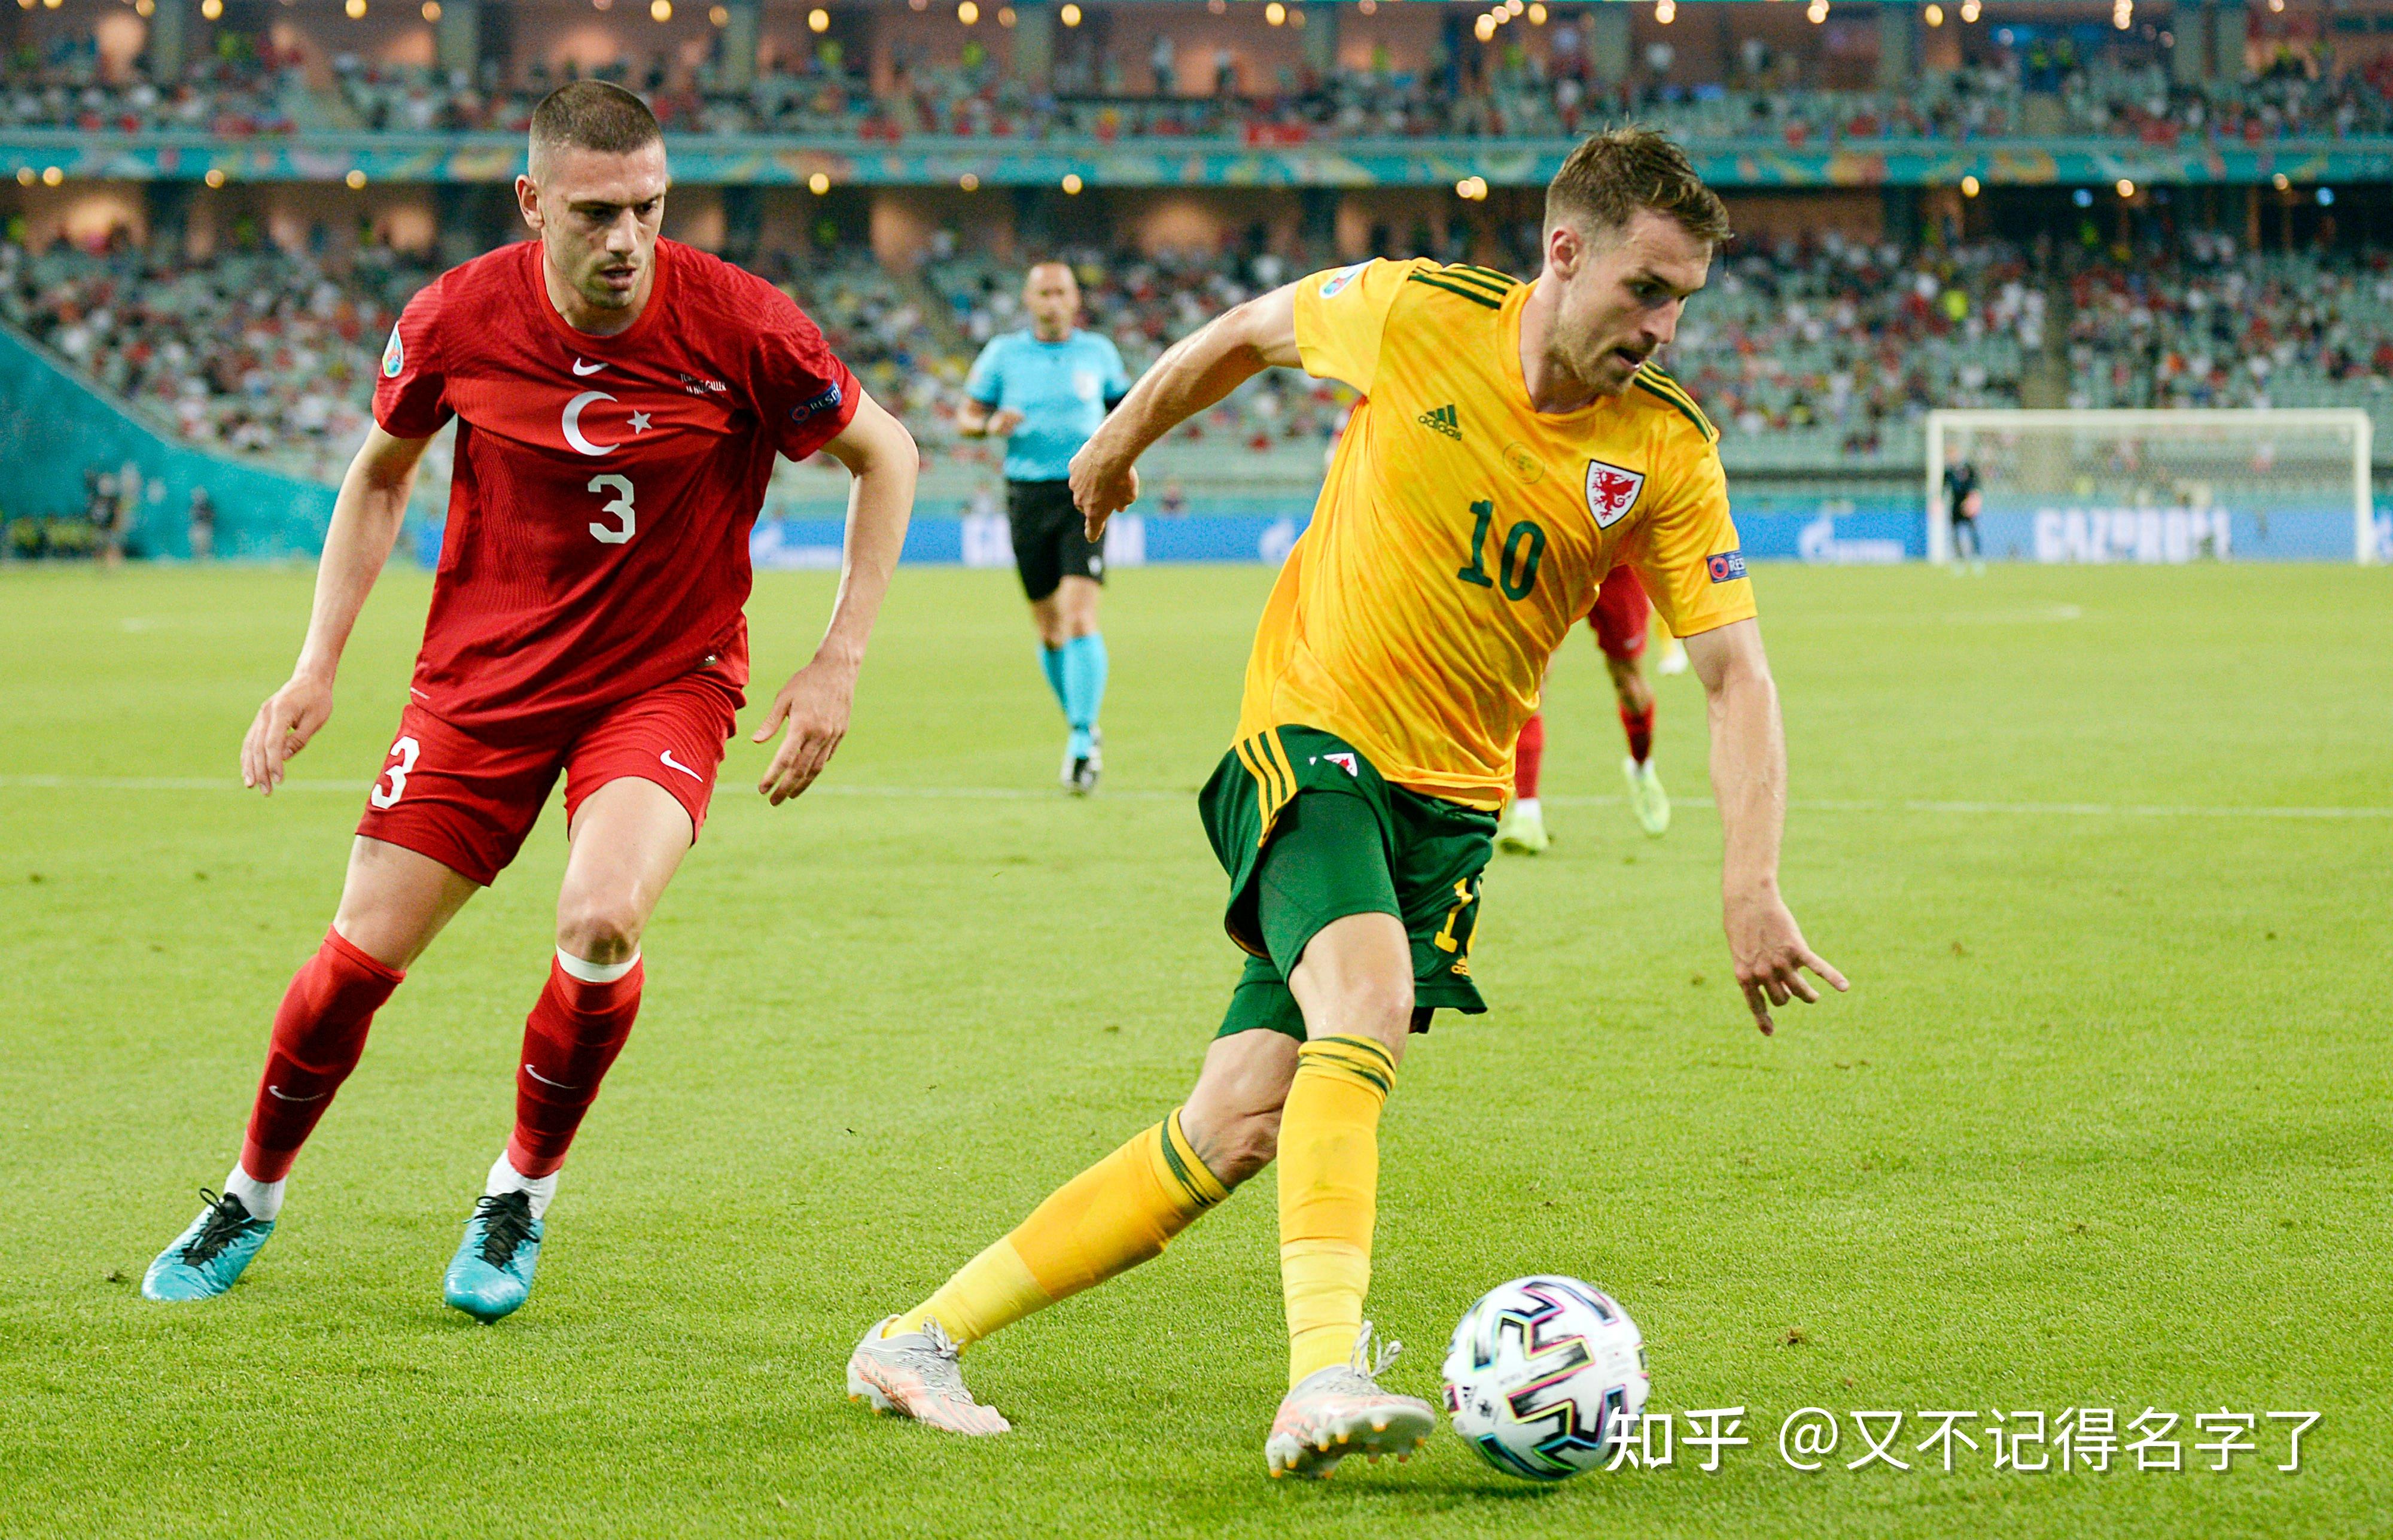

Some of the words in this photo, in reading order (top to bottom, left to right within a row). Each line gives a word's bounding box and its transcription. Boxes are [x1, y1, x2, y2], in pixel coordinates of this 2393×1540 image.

[1418, 415, 1462, 441] adidas
[588, 475, 635, 543] 3
[1457, 500, 1546, 601] 10
[370, 736, 420, 809] 3
